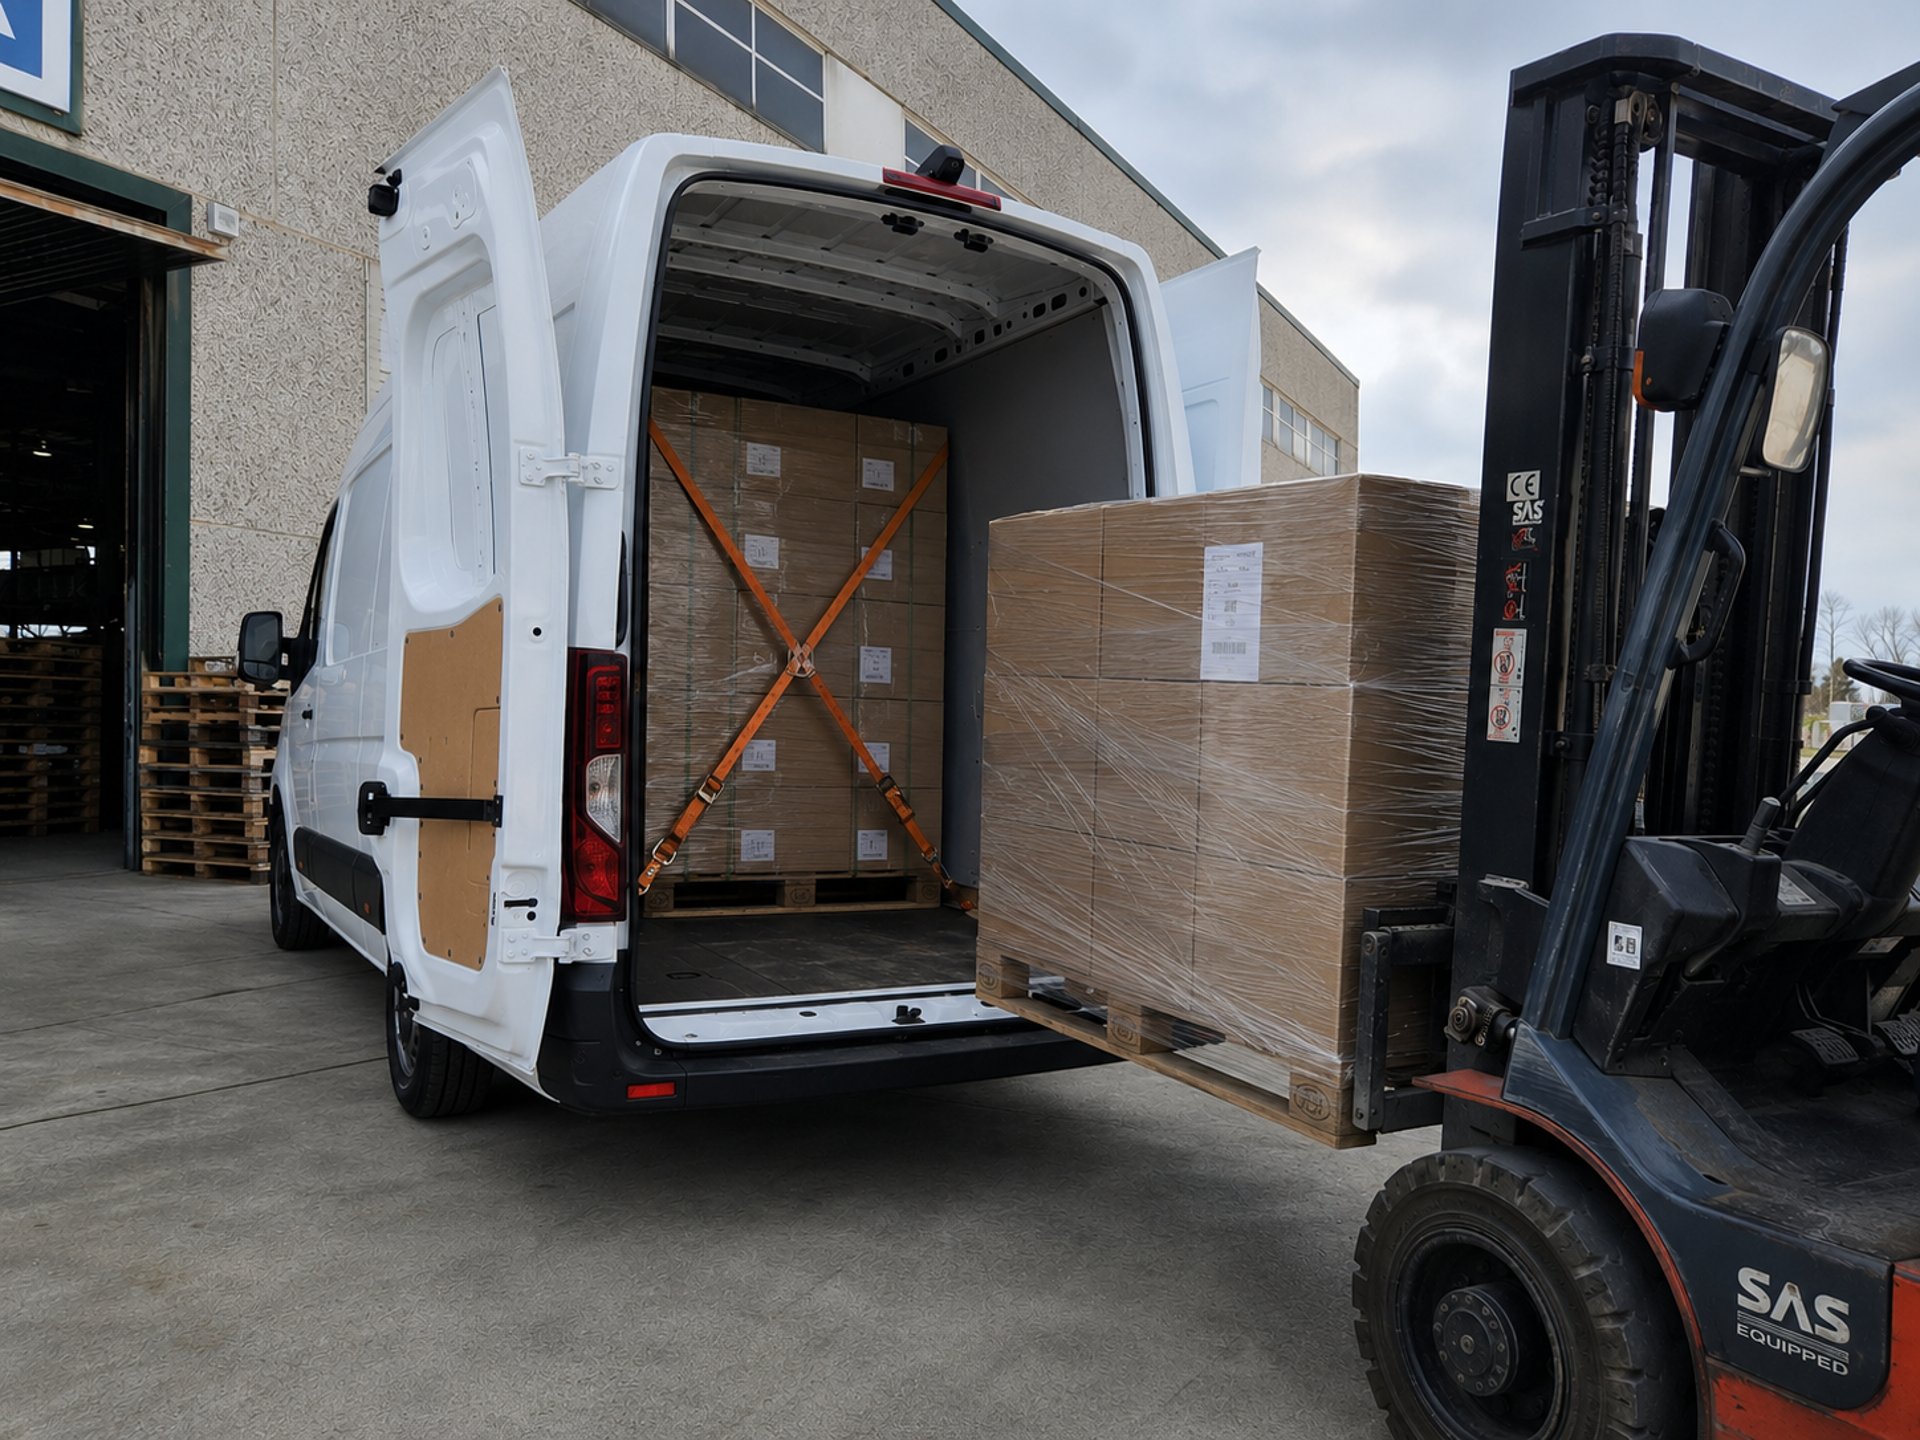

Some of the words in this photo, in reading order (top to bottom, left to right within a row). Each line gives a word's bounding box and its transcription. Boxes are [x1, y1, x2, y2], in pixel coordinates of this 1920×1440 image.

[1510, 474, 1536, 497] CE
[1512, 500, 1545, 521] SAS
[1737, 1267, 1851, 1344] SAS
[1737, 1324, 1848, 1376] EQUIPPED
